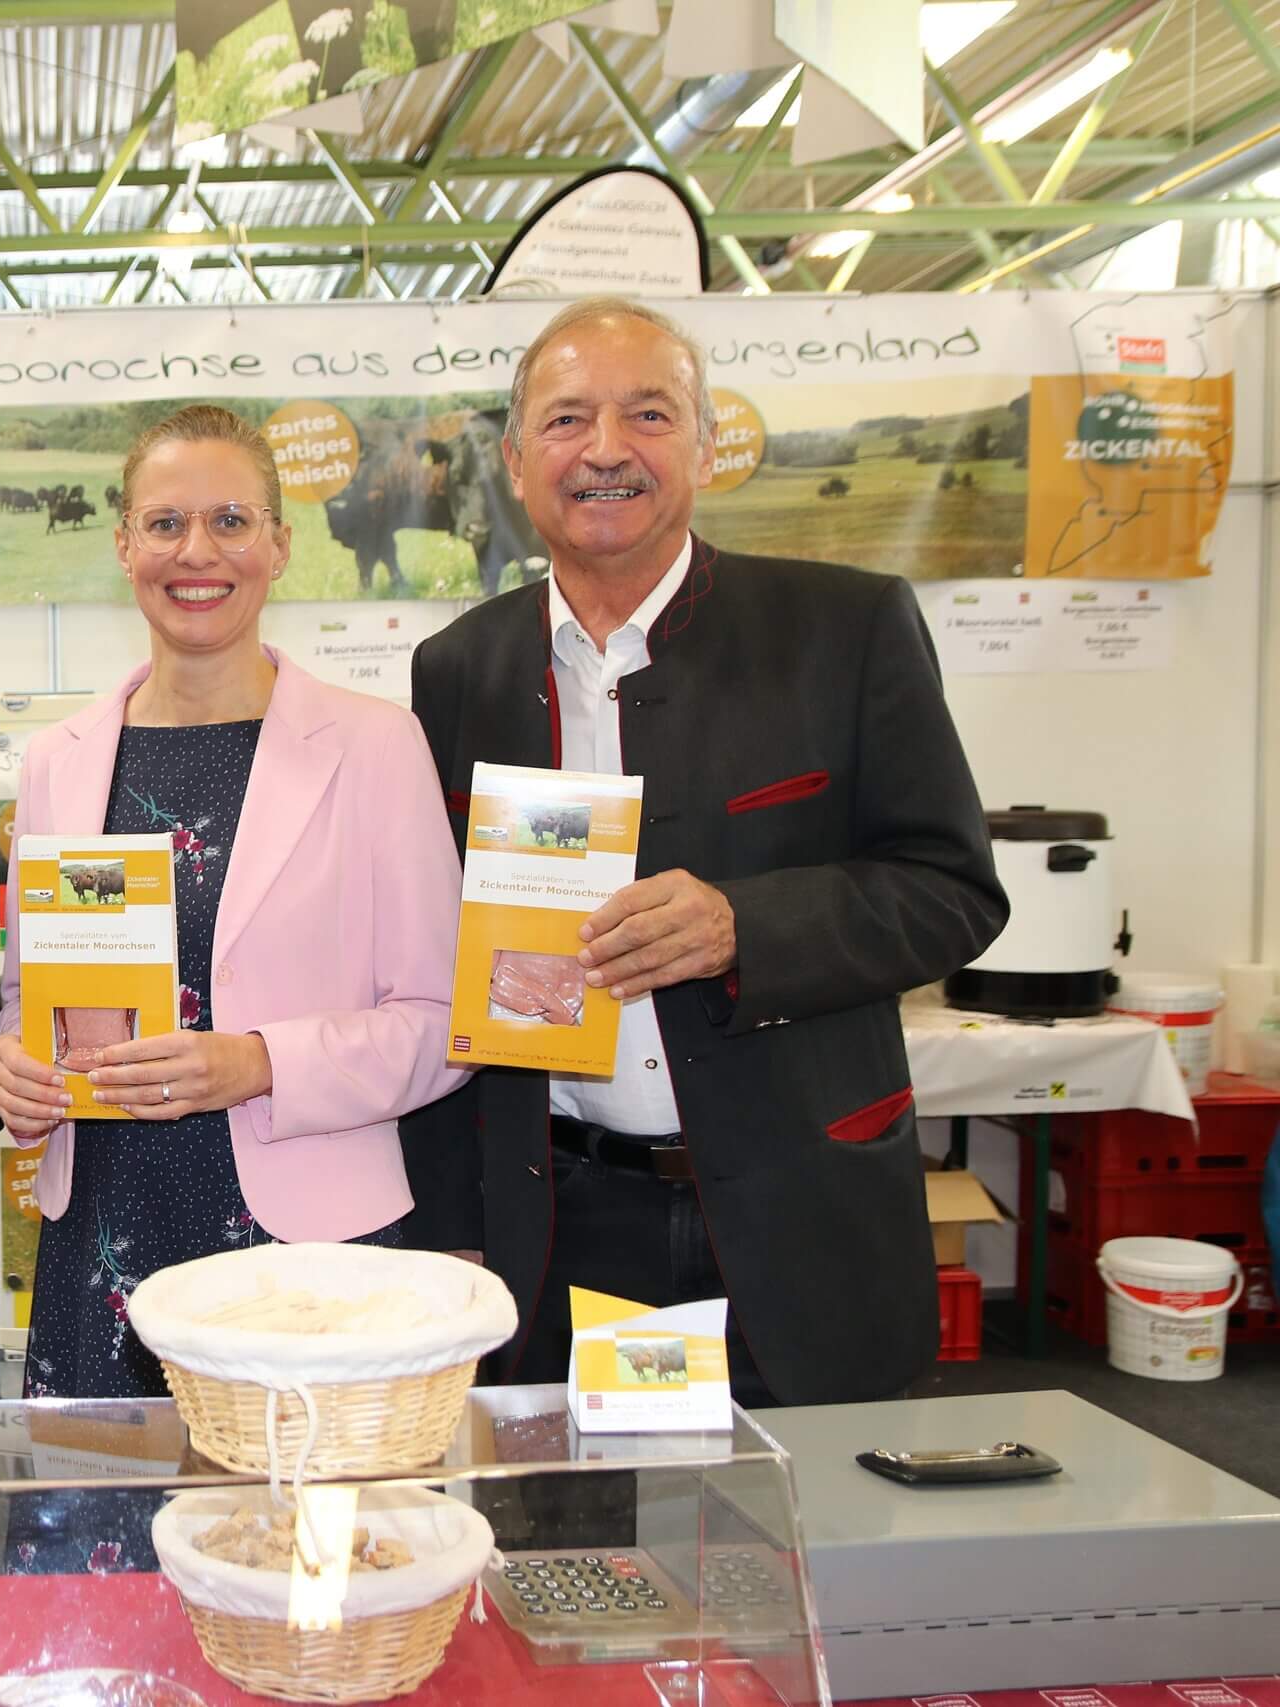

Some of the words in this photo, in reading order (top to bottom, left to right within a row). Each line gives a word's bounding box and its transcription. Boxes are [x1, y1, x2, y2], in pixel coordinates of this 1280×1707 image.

[293, 351, 389, 378] aus
[413, 344, 528, 374] dem
[711, 327, 980, 378] urgenland
[268, 415, 337, 439] zartes
[715, 428, 758, 447] utz-
[272, 437, 352, 464] aftiges
[1062, 438, 1208, 461] ZICKENTAL
[712, 450, 755, 474] biet
[480, 880, 543, 893] Zickentaler
[546, 886, 613, 898] Moorochsen
[33, 941, 90, 950] Zickentaler
[94, 941, 155, 950] Moorochsen
